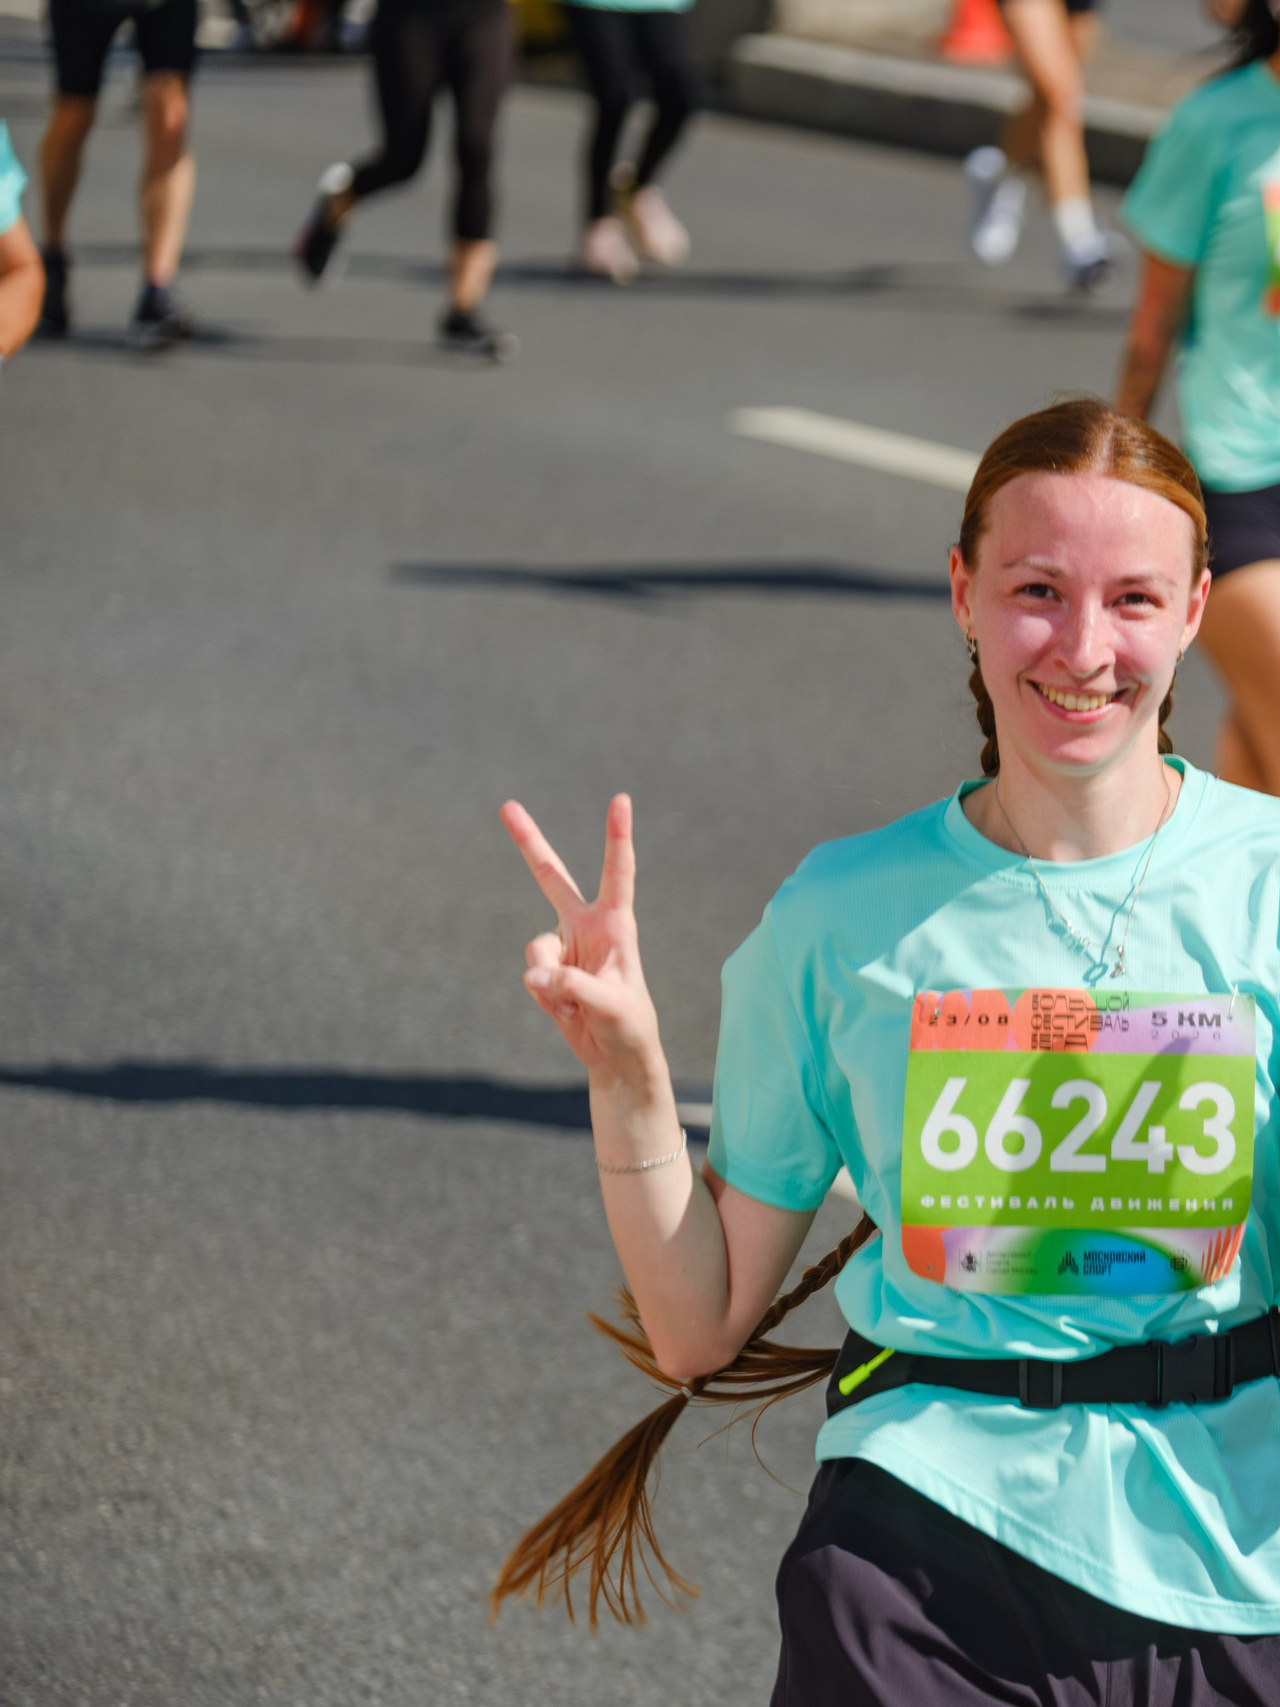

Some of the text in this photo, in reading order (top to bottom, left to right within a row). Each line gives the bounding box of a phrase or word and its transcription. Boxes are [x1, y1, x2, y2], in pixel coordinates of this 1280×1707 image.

[1031, 991, 1130, 1012] БОЛЬШОЙ
[1030, 1014, 1130, 1032] ФЕСТИВАЛЬ
[1151, 1011, 1168, 1028] 5
[920, 1076, 1237, 1176] 66243
[920, 1194, 1234, 1212] ФЕСТИВАЛЬ ДВИЖЕНИЯ
[1083, 1248, 1146, 1264] МОСКОВСКИЙ
[1083, 1264, 1111, 1276] СПОРТ
